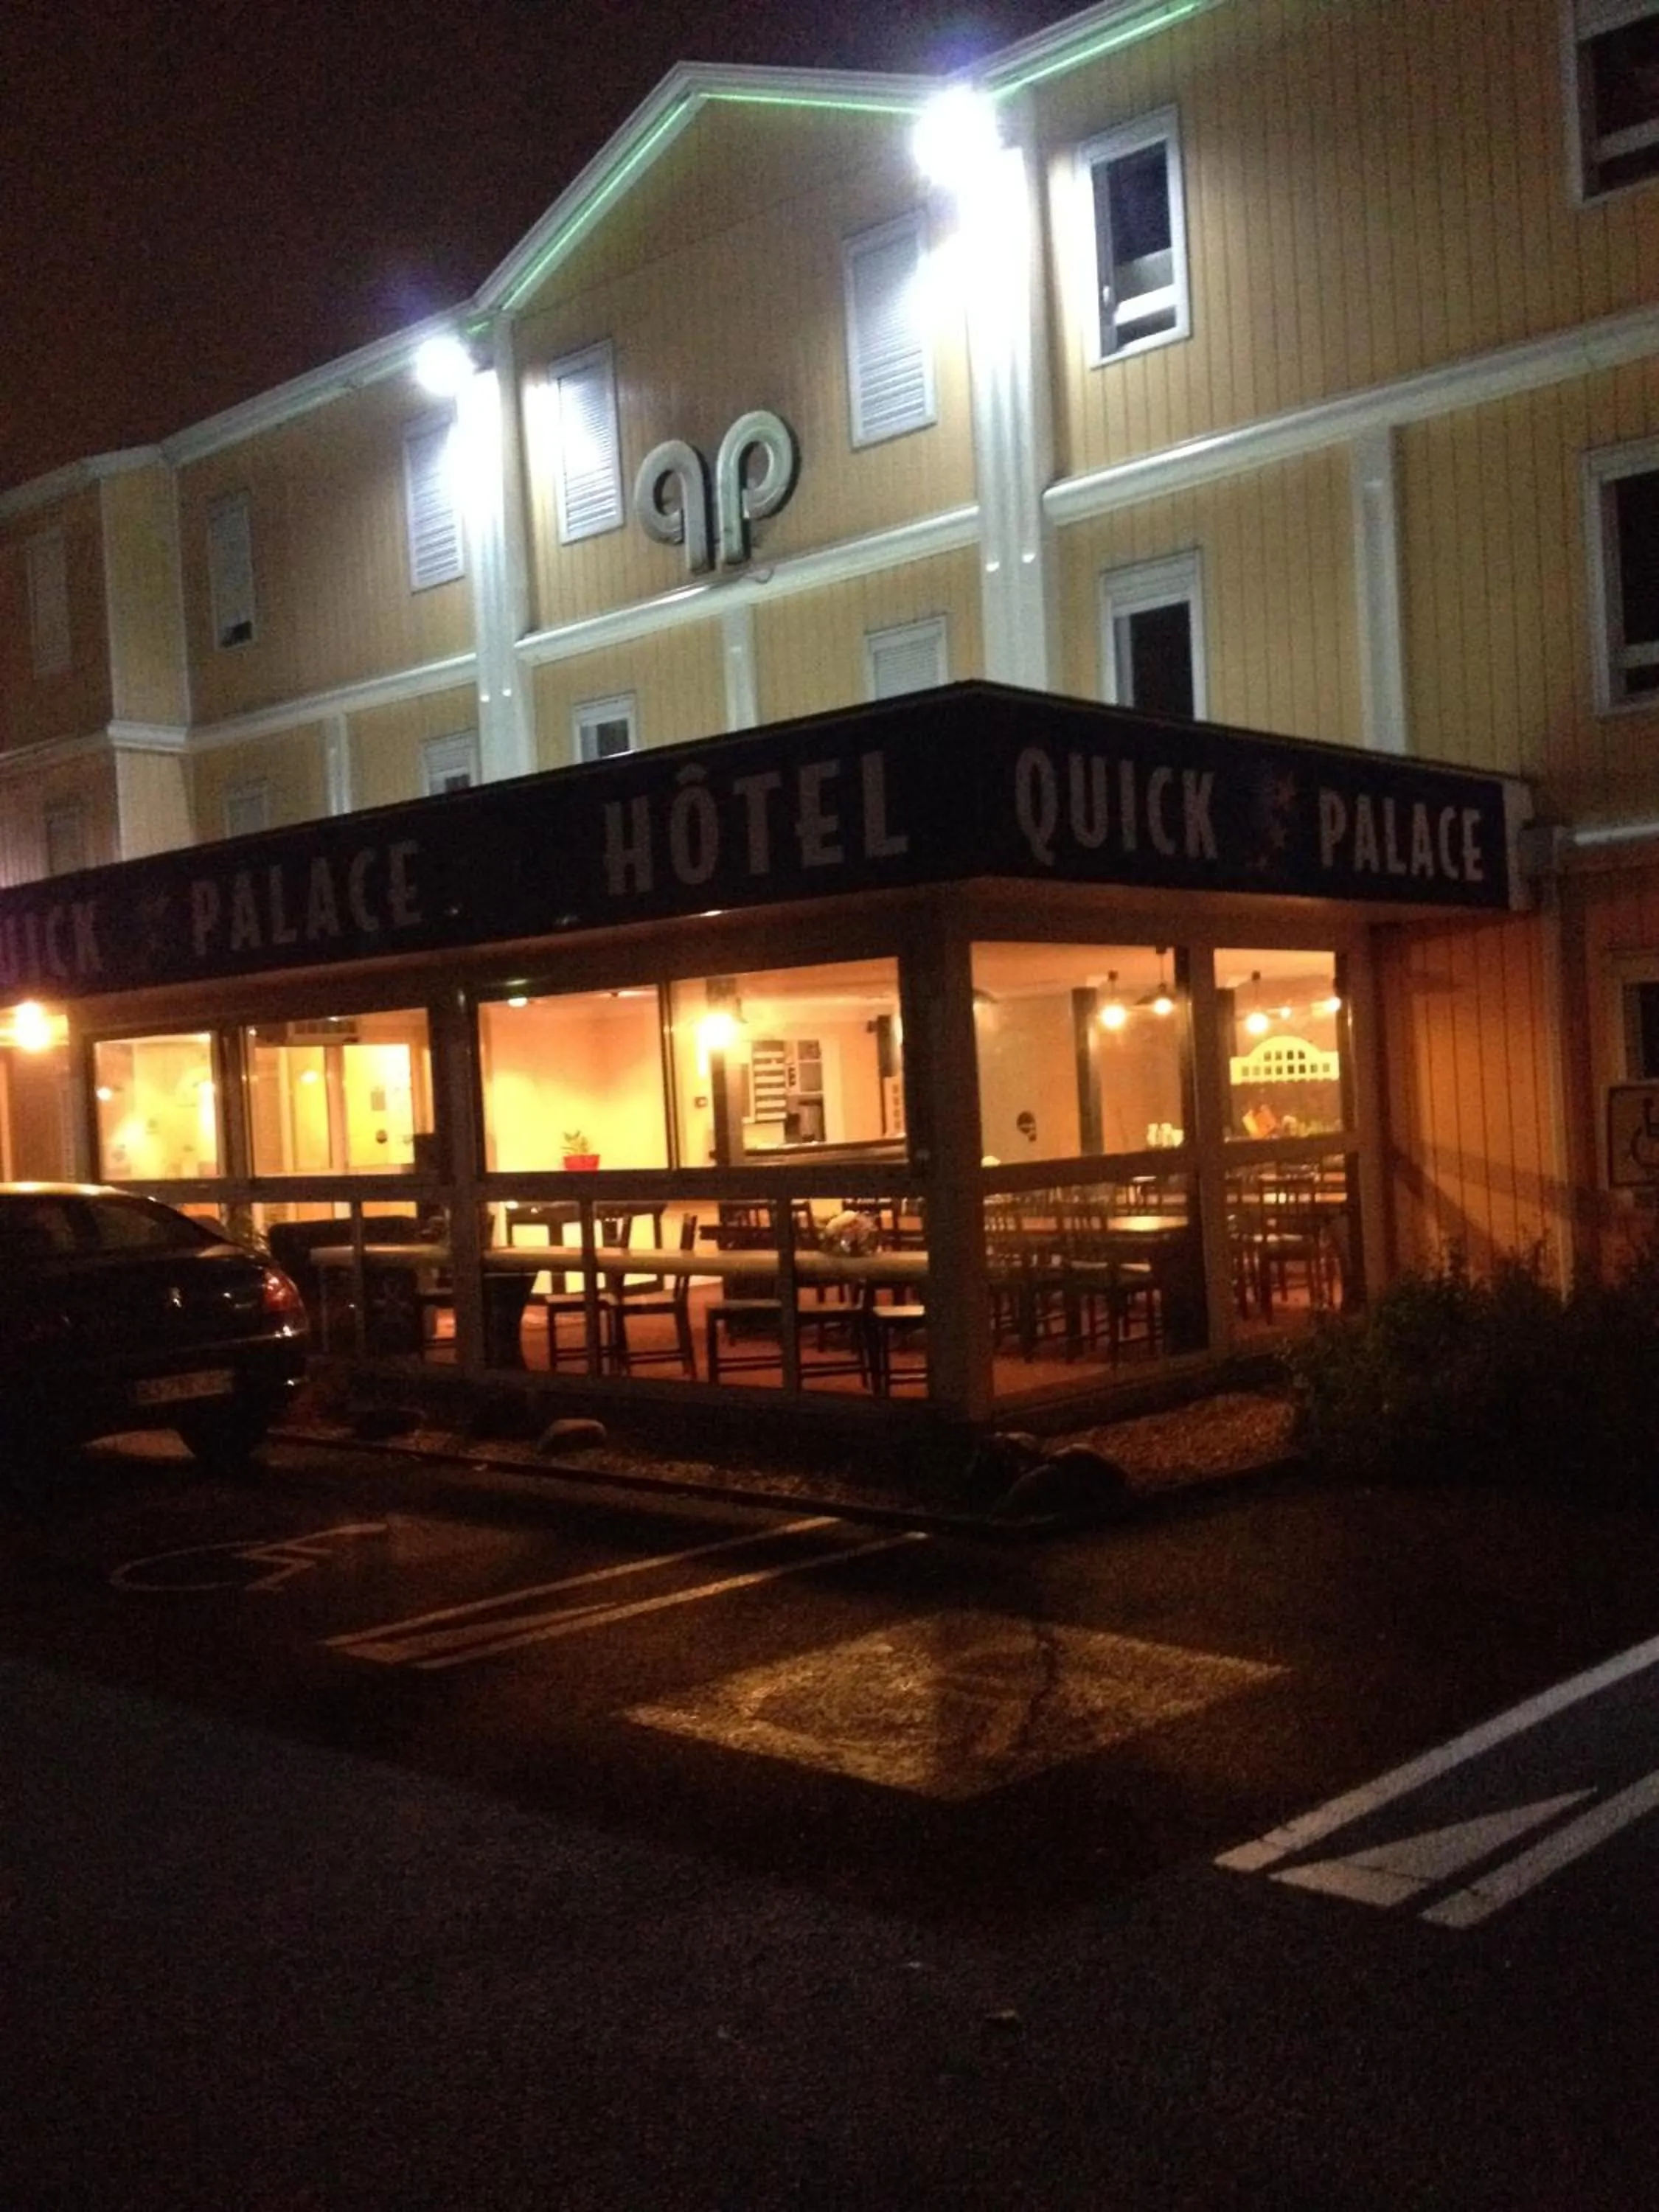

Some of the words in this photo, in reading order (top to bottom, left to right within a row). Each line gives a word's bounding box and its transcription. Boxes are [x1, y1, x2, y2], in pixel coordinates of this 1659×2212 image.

[191, 839, 424, 957] PALACE
[602, 751, 908, 897] HÔTEL
[1015, 746, 1218, 867] QUICK
[1318, 786, 1484, 882] PALACE
